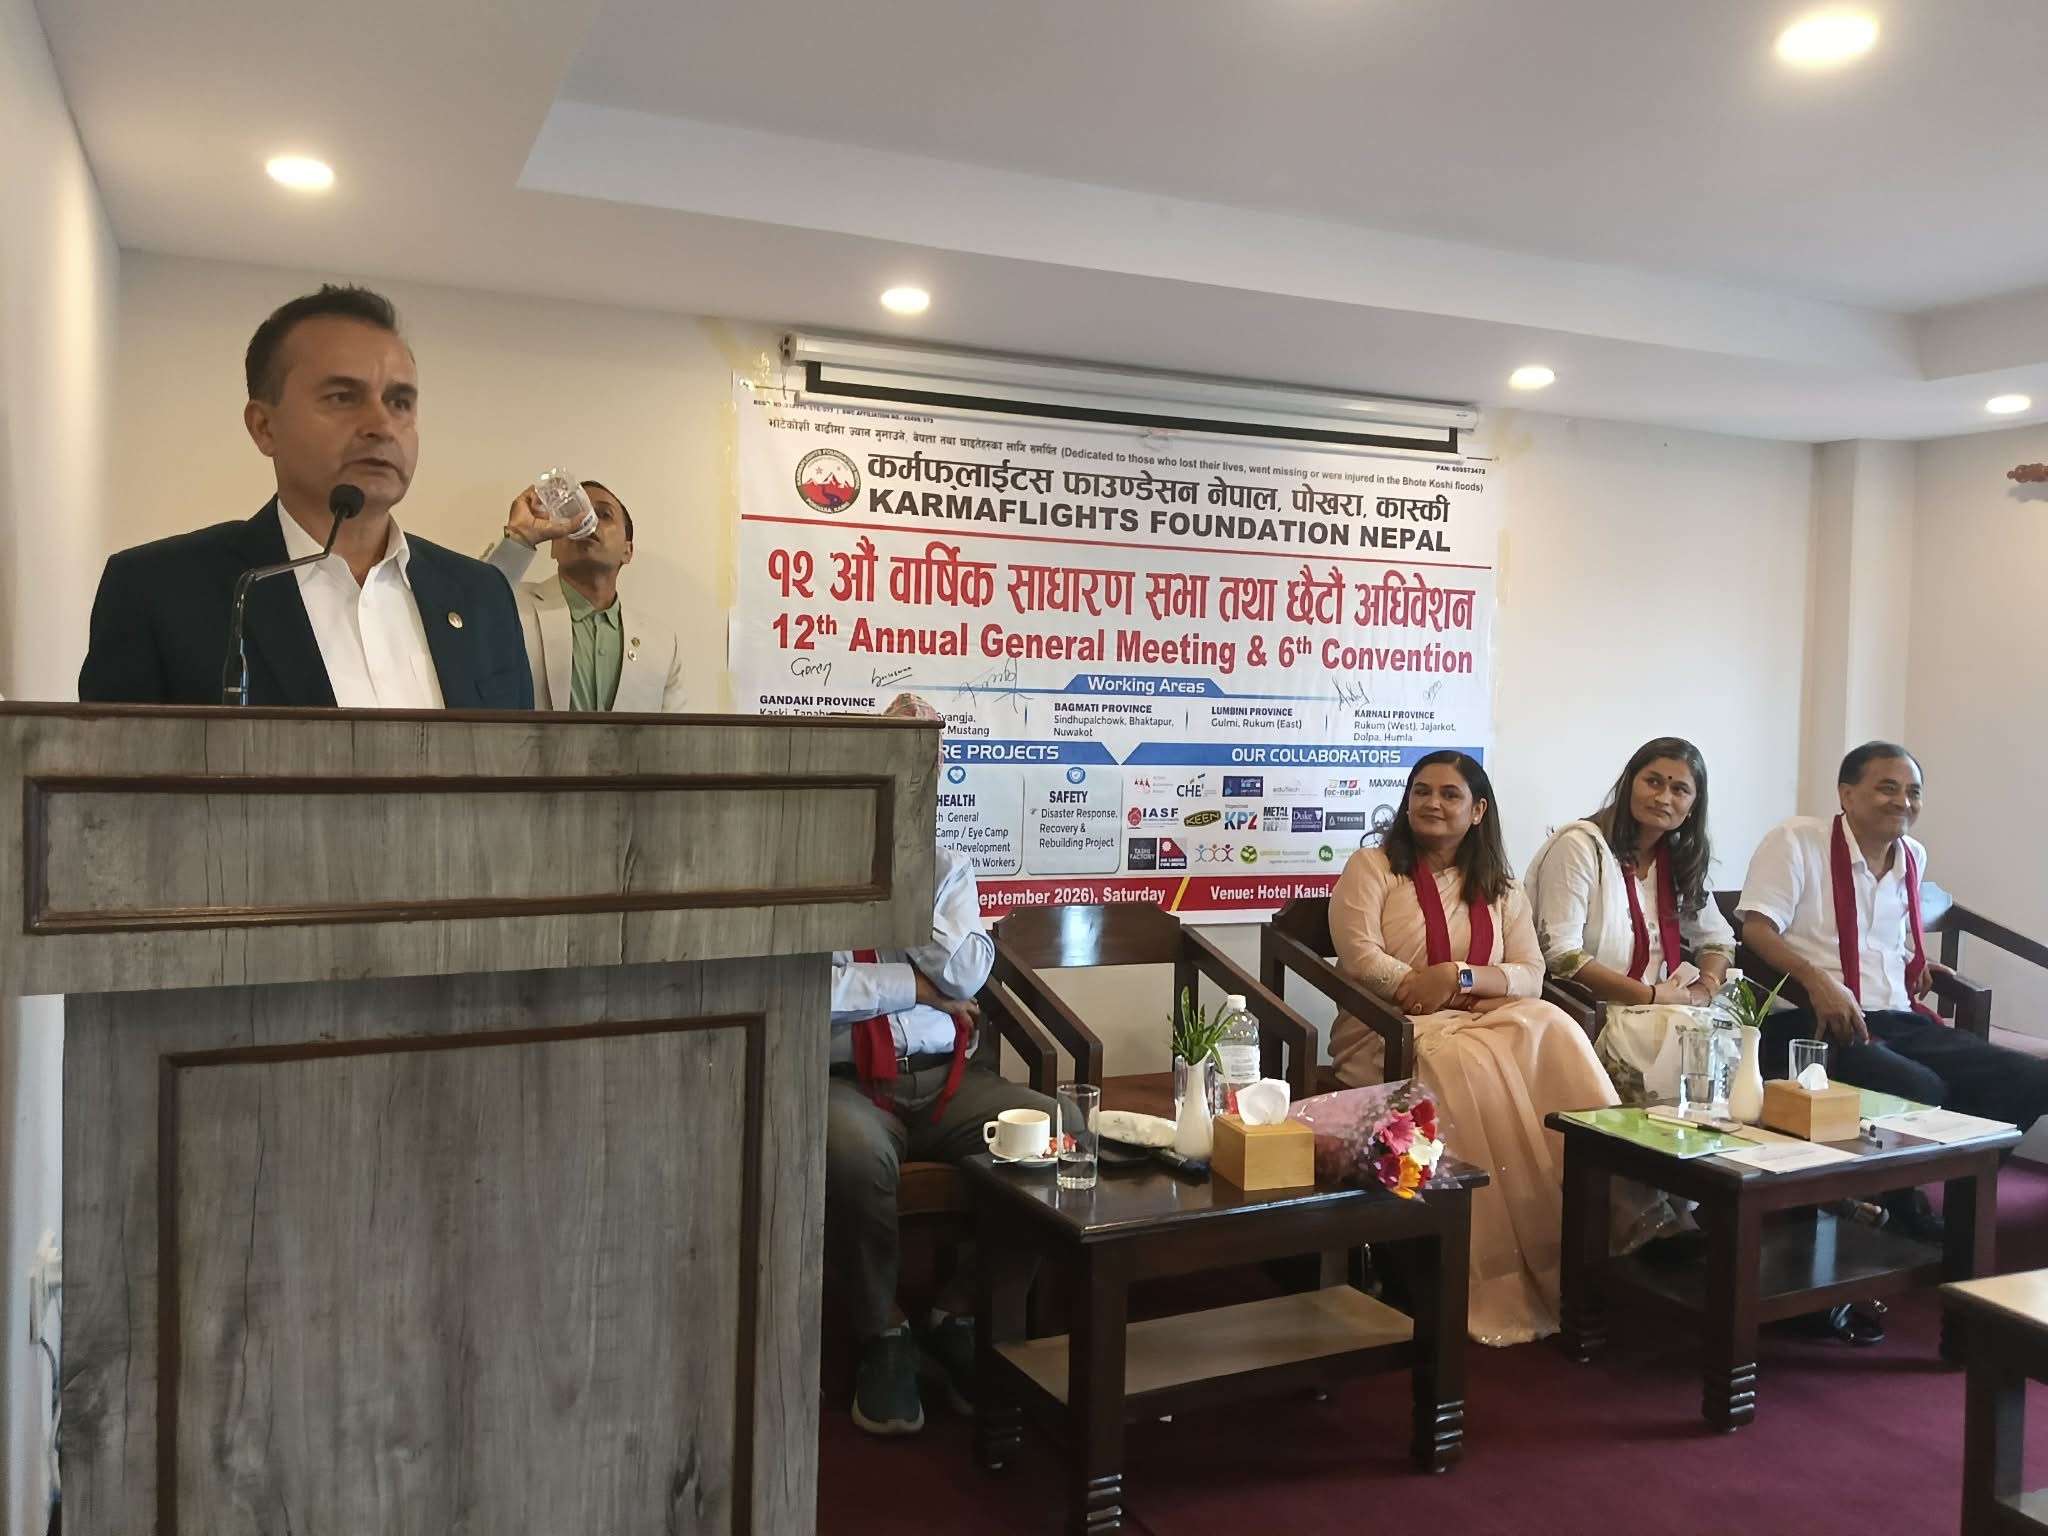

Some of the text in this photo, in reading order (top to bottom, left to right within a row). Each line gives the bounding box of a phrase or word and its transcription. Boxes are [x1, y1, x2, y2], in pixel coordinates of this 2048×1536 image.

[1061, 447, 1113, 462] (Dedicated
[1116, 453, 1126, 462] to
[1128, 453, 1155, 465] those
[1158, 457, 1177, 466] who
[1180, 457, 1197, 468] lost
[1199, 460, 1221, 470] their
[1223, 461, 1247, 474] lives,
[1249, 465, 1271, 475] went
[1273, 467, 1308, 479] missing
[1310, 470, 1320, 478] or
[1322, 471, 1343, 480] were
[1344, 472, 1375, 484] injured
[1377, 474, 1385, 484] in
[1387, 475, 1401, 485] the
[1403, 477, 1427, 488] Bhote
[1429, 479, 1453, 490] Koshi
[1455, 481, 1484, 493] floods)
[1063, 469, 1200, 506] फाउण्डेसन
[1208, 476, 1281, 513] नेपाल,
[1292, 483, 1367, 519] पोखरा,
[1376, 494, 1450, 523] कास्की
[869, 488, 1138, 532] KARMAFLIGHTS
[1151, 510, 1349, 546] FOUNDATION
[1360, 524, 1451, 552] NEPAL
[768, 548, 815, 599] १२
[890, 541, 997, 608] वार्षिक
[1008, 563, 1136, 617] साधारण
[1146, 572, 1210, 621] सभा
[1219, 577, 1278, 624] तथा
[1354, 569, 1476, 632] अधिवेशन
[773, 612, 1473, 674] 12th Annual General Meeting & 6th Convention
[1088, 676, 1205, 694] Working Areas
[760, 695, 876, 707] GANDAKI PROVINCE
[1054, 702, 1152, 714] BAGMATI PROVINCE
[1211, 706, 1293, 717] LUMBINI PROVINCE
[936, 712, 976, 724] Syangja,
[1354, 710, 1435, 719] KARNALI PROVINCE
[1054, 715, 1174, 728] Sindhupalchowk, Bhaktapur,
[1211, 718, 1302, 730] Gulmi, Rukum (East)
[1354, 721, 1457, 732] Rukum (West), Jajarkot,
[947, 725, 990, 737] Mustang
[1053, 727, 1093, 738] Nuwakot
[1354, 733, 1413, 743] Dolpa, Humla
[943, 744, 1059, 760] RE PROJECTS
[1232, 748, 1401, 764] OUR COLLABORATORS
[936, 794, 976, 806] HEALTH
[1049, 790, 1088, 803] SAFETY
[947, 811, 979, 822] General
[1041, 808, 1118, 821] Disaster Response,
[1143, 808, 1179, 818] IASF
[1263, 806, 1288, 816] METAL
[1293, 810, 1313, 820] Duke
[1184, 812, 1220, 826] KEEN
[935, 827, 960, 839] Camp
[968, 827, 983, 839] Eye
[985, 827, 1009, 839] Camp
[1040, 823, 1086, 835] Recovery &
[957, 842, 1011, 854] Development
[1039, 837, 1114, 849] Rebuilding Project
[982, 857, 1016, 868] Workers
[979, 886, 1166, 909] eptember 2026), Saturday
[1210, 885, 1254, 900] Venue:
[1258, 884, 1291, 899] Hotel
